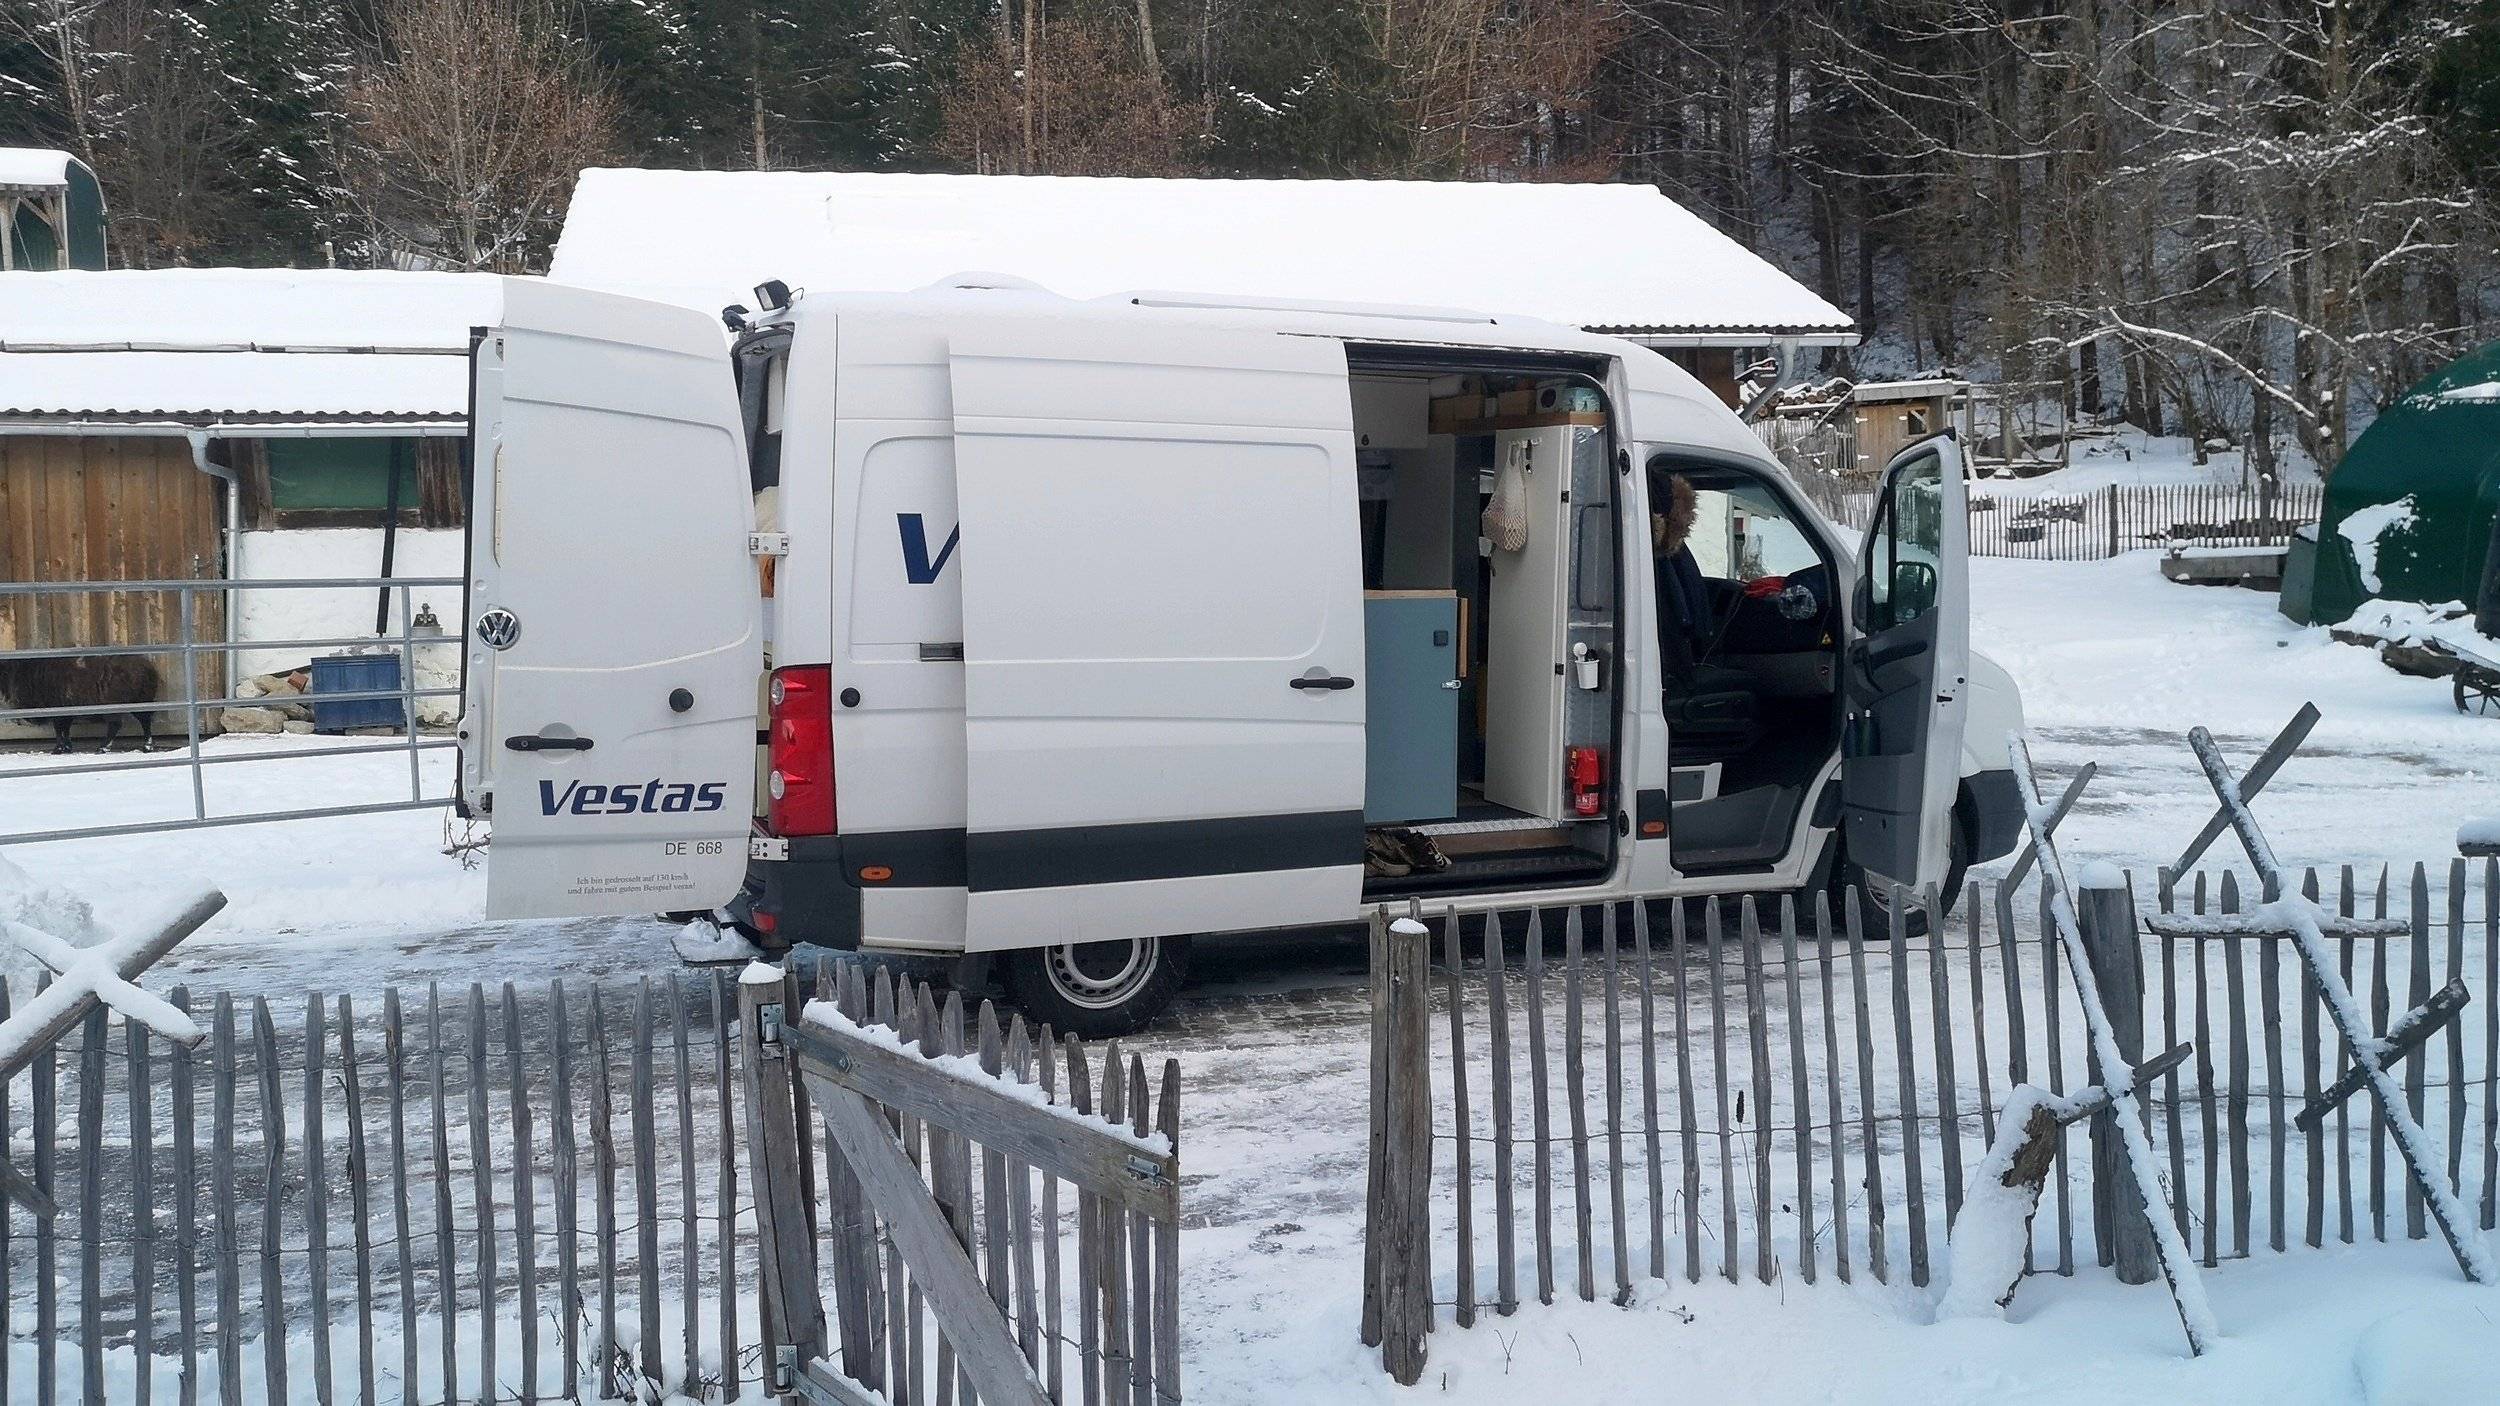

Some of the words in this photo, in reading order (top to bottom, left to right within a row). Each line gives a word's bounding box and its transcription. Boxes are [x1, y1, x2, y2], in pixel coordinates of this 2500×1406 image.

[539, 778, 727, 816] Vestas
[665, 842, 687, 856] DE
[696, 841, 723, 855] 668
